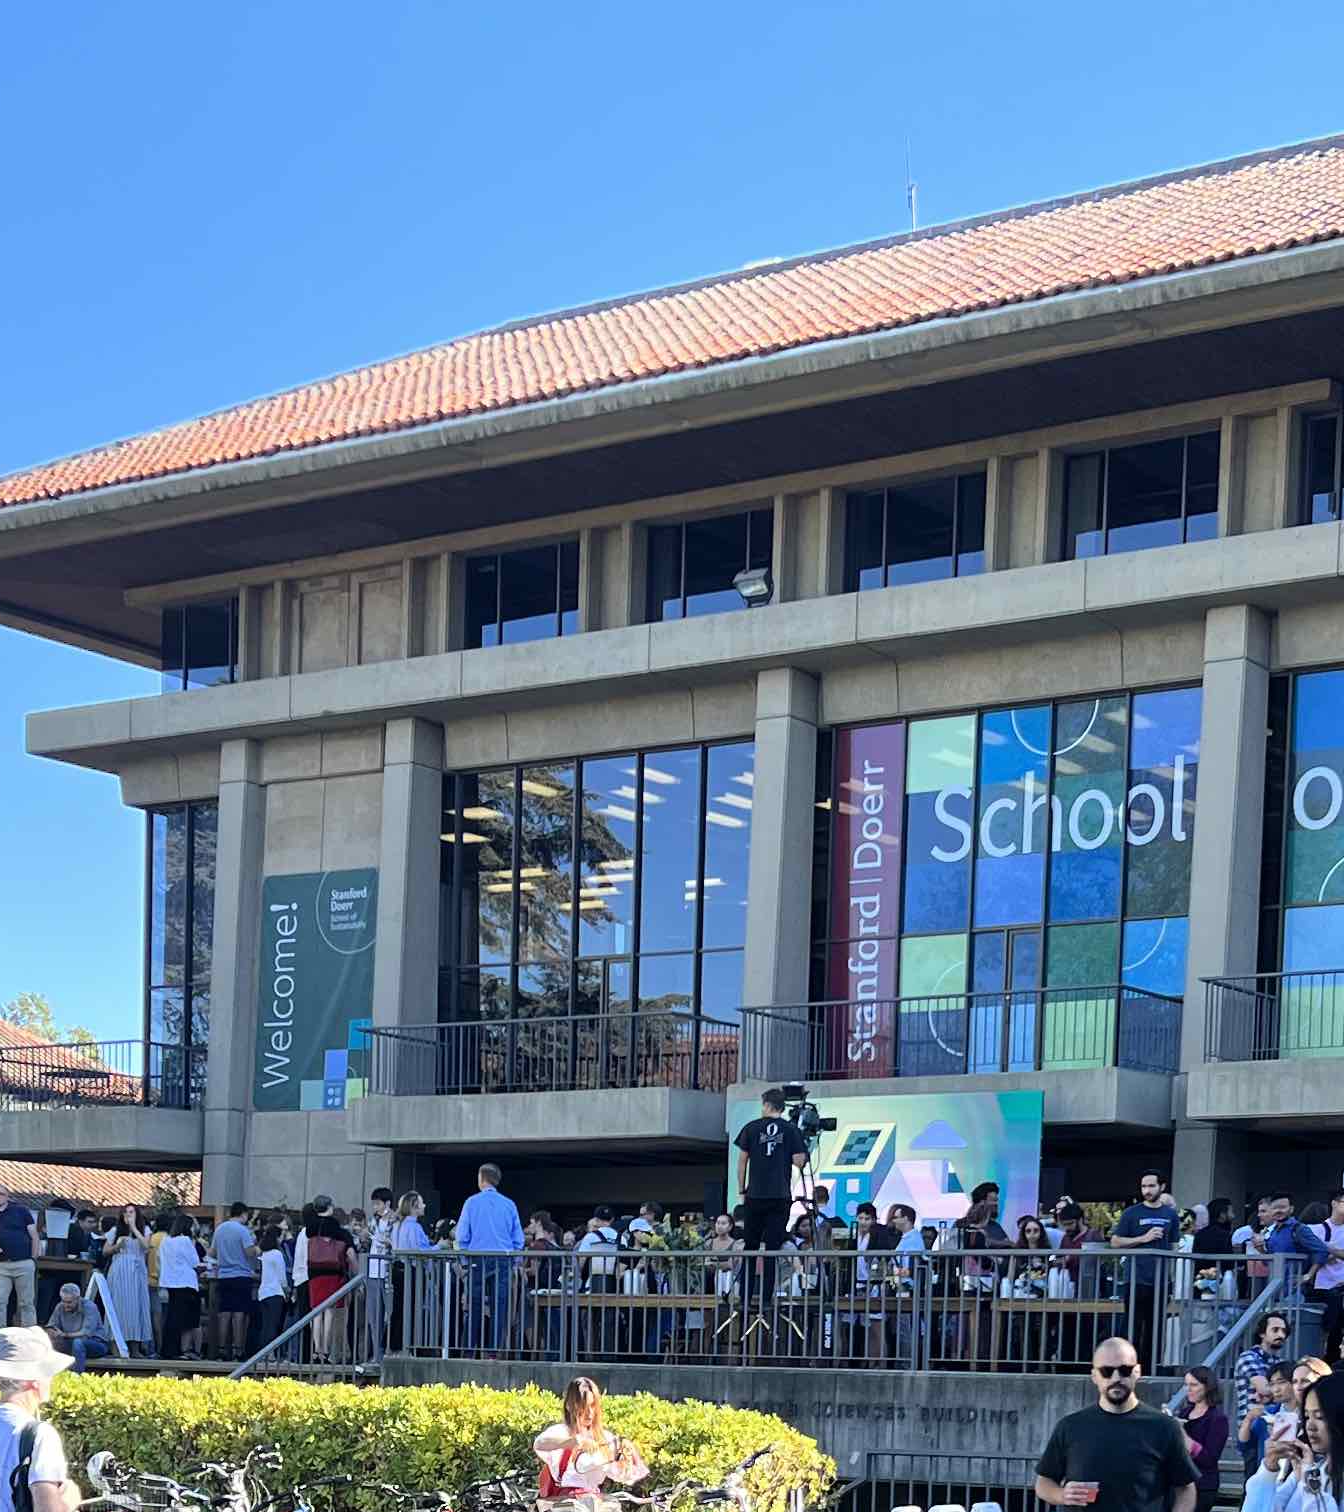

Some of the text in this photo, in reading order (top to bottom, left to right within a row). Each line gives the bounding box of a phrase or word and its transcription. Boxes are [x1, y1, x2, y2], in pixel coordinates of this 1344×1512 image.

[930, 754, 1186, 862] School
[331, 886, 367, 900] Stanford
[847, 759, 884, 1062] Stanford Doerr
[261, 901, 299, 1088] Welcome!
[920, 1406, 1019, 1425] BUILDING
